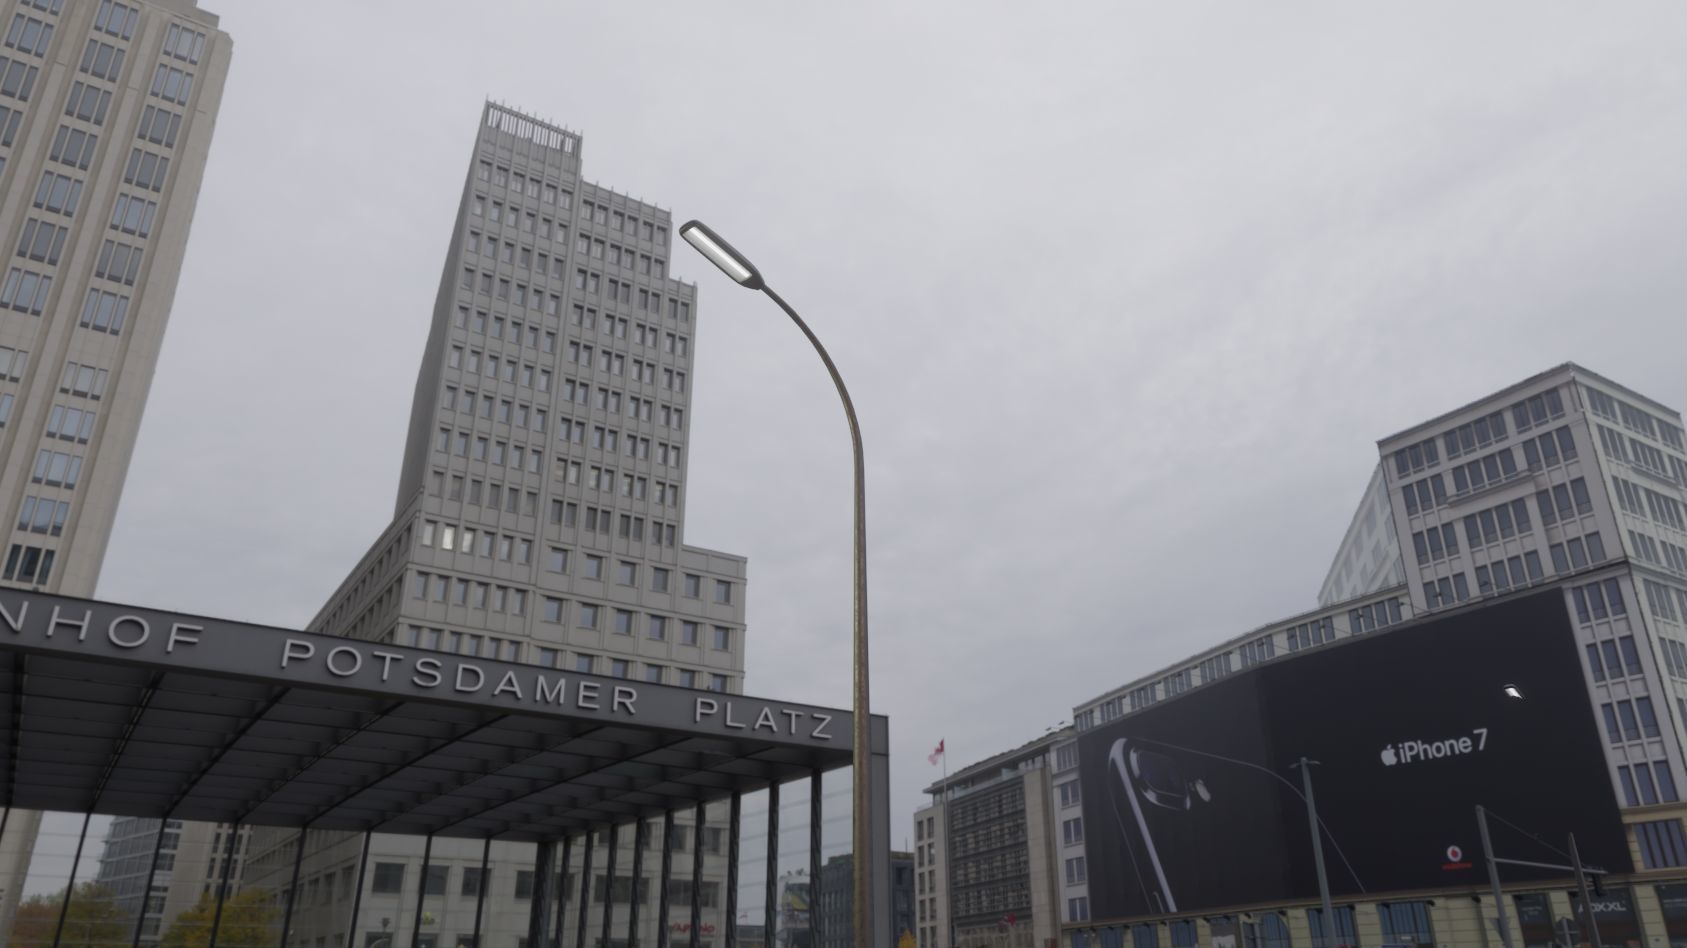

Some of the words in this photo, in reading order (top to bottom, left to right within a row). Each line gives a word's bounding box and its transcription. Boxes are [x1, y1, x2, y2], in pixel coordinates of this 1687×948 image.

[281, 637, 639, 714] POTSDAMER
[695, 696, 833, 740] PLATZ
[1398, 737, 1474, 765] iPhone
[1473, 727, 1489, 751] 7
